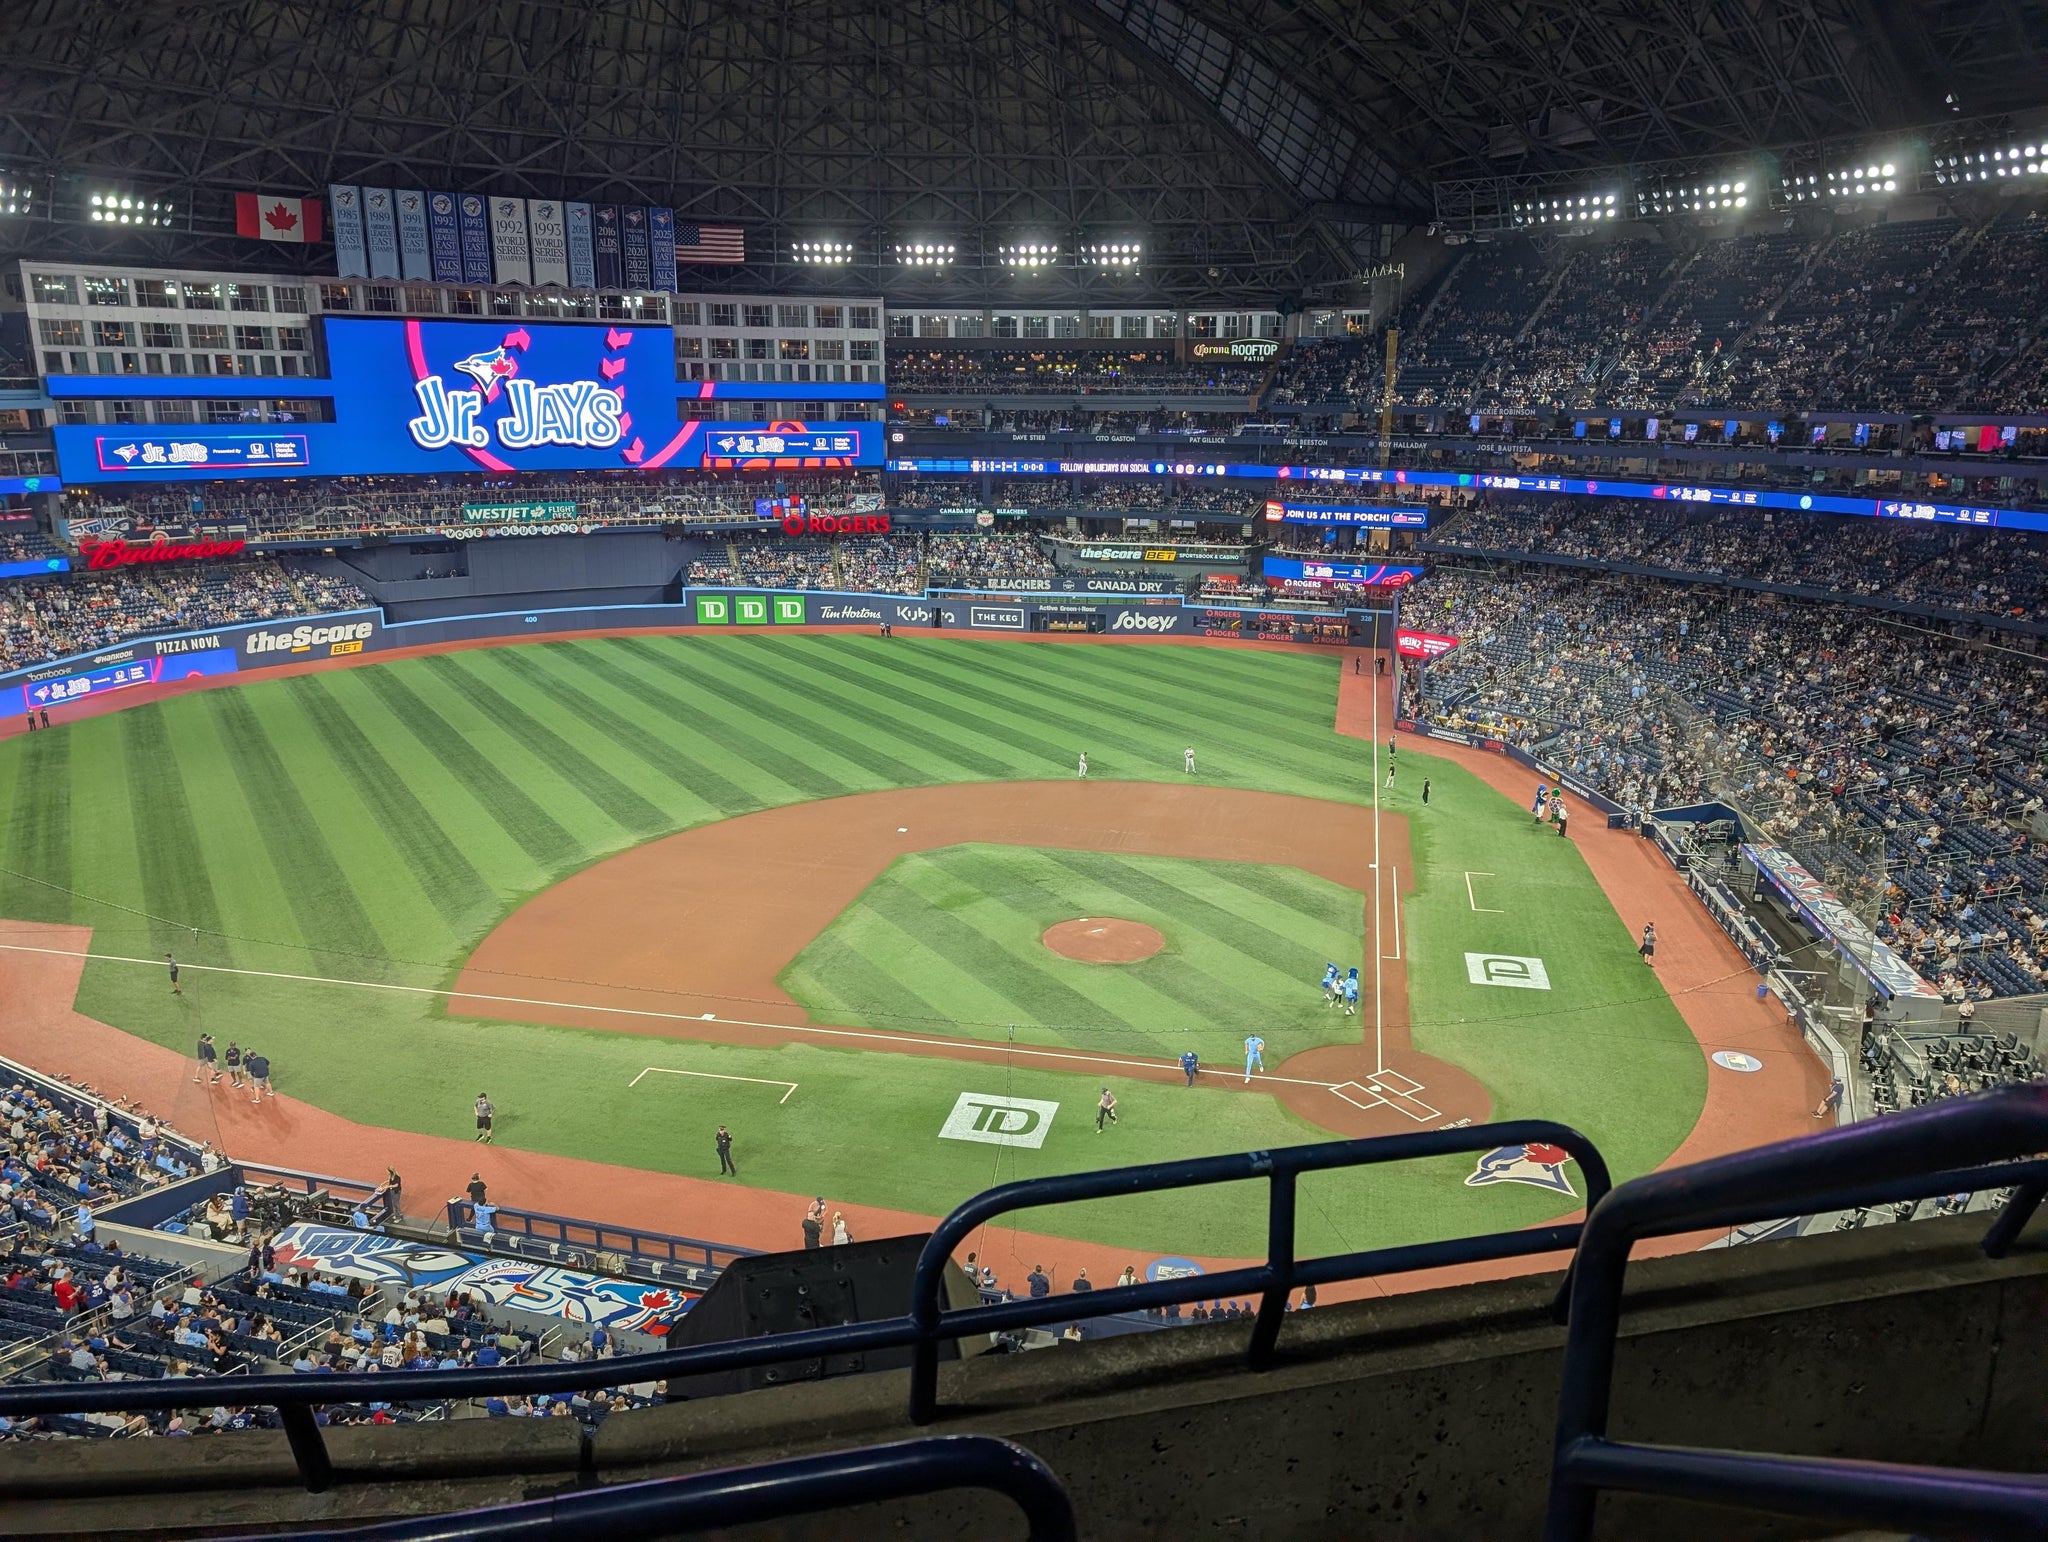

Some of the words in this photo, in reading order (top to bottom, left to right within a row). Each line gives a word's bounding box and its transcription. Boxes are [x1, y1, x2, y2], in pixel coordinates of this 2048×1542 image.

[337, 209, 358, 220] 1985
[370, 212, 390, 222] 1989
[403, 214, 422, 224] 1991
[434, 216, 454, 226] 1992
[464, 218, 484, 228] 1993
[496, 220, 523, 234] 1992
[534, 222, 562, 236] 1993
[572, 225, 588, 234] 2015
[598, 226, 616, 236] 2016
[627, 234, 644, 243] 2016
[654, 230, 672, 239] 2025
[338, 236, 360, 244] EAST
[372, 238, 392, 246] EAST
[404, 239, 424, 248] EAST
[496, 236, 525, 245] WORLD
[534, 238, 563, 248] WORLD
[436, 241, 456, 250] EAST
[466, 242, 486, 252] EAST
[496, 246, 526, 255] SERIES
[534, 248, 564, 258] SERIES
[627, 247, 646, 256] 2020
[656, 252, 672, 260] EAST
[439, 260, 458, 270] ALCS
[468, 262, 488, 271] ALCS
[628, 260, 646, 269] 2022
[629, 273, 648, 282] 2023
[1194, 344, 1229, 357] Corona
[1232, 344, 1278, 356] ROOFTOP
[409, 376, 489, 448] Jr.
[498, 379, 622, 447] JAYS
[738, 436, 754, 452] Jr.
[756, 436, 785, 452] JAYS
[142, 442, 166, 463] Jr.
[169, 442, 208, 463] JAYS
[1060, 463, 1082, 472] FOLLOW
[1084, 464, 1118, 472] @BLUEJAYS
[1120, 464, 1128, 472] ON
[1130, 464, 1150, 472] SOCIAL
[467, 507, 529, 522] WESTJET
[1286, 510, 1304, 518] JOIN
[1307, 511, 1318, 519] US
[808, 516, 890, 533] ROGERS
[447, 528, 482, 538] VOTE
[502, 527, 538, 536] BLUE
[544, 524, 578, 534] JAYS
[80, 536, 245, 569] Budweiser
[1081, 548, 1142, 560] theScore
[1088, 581, 1136, 592] CANADA
[700, 602, 725, 618] TD
[738, 602, 764, 618] TD
[777, 602, 802, 618] TD
[821, 606, 840, 618] Tim
[842, 606, 880, 618] Hortons
[1112, 611, 1178, 632] Sobeys
[246, 622, 372, 654] theScore
[1400, 637, 1422, 649] HEINZ
[156, 640, 188, 654] PIZZA
[191, 635, 220, 650] NOVA
[334, 642, 360, 653] BET
[1398, 721, 1416, 731] HEINZ
[967, 1102, 1040, 1135] TD
[472, 1260, 540, 1278] TORONTO
[92, 1288, 102, 1297] 30
[384, 1355, 393, 1364] 25
